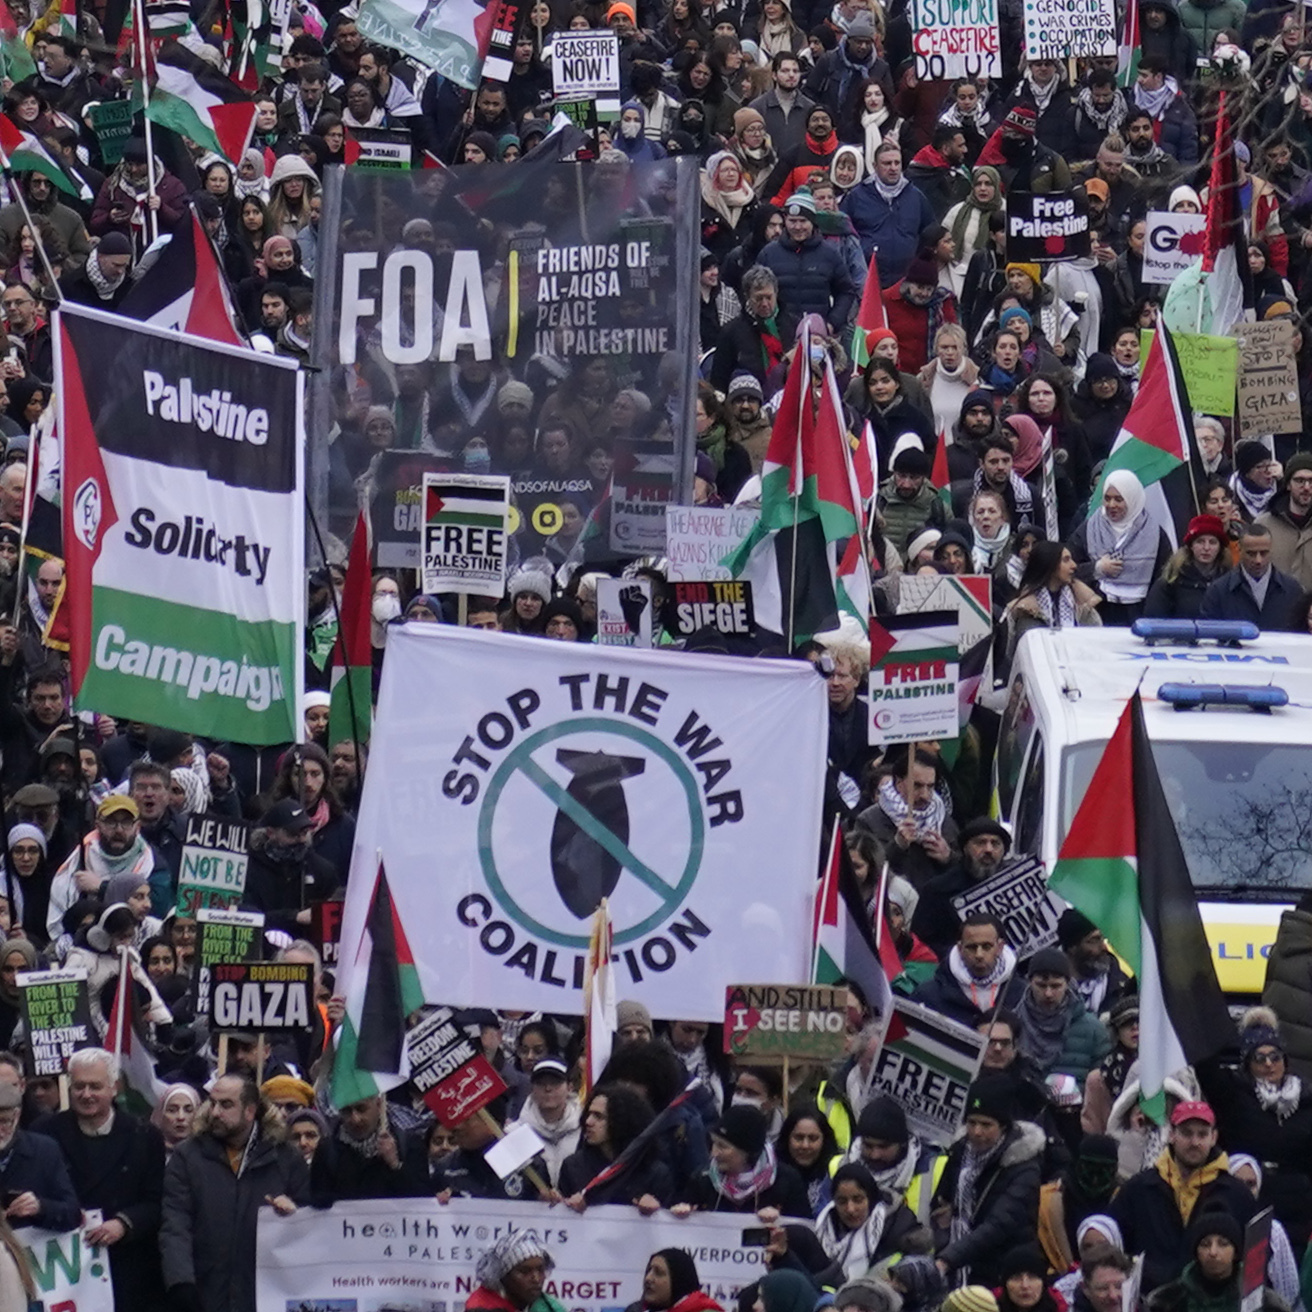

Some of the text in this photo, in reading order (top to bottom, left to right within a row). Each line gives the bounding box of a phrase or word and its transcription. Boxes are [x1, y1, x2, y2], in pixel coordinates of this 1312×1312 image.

[1038, 12, 1112, 29] WAR CRIMES
[913, 26, 999, 57] CEASEFIRE
[1039, 28, 1117, 43] OCCUPATION
[554, 39, 615, 59] CEASEFIRE
[1039, 41, 1109, 60] HYPOCRISY
[562, 58, 611, 82] NOW!
[915, 53, 946, 82] DO
[1032, 197, 1075, 217] Free
[1009, 214, 1088, 238] Palestine
[538, 242, 652, 274] FRIENDS OF
[538, 270, 621, 302] AL-AQSA
[339, 249, 493, 365] FOA
[536, 299, 598, 328] PEACE
[535, 327, 669, 355] IN PALESTINE
[1241, 349, 1286, 365] STOP
[143, 370, 269, 445] Palstine
[1244, 392, 1289, 412] GAZA
[425, 526, 504, 558] FREE
[425, 554, 503, 572] PALESTINE
[675, 582, 745, 603] END THE
[676, 602, 749, 633] SIEGE
[95, 624, 286, 712] Campaign
[883, 660, 948, 686] FREE
[872, 682, 956, 703] PALESTINE
[441, 672, 745, 829] STOP THE WAR
[187, 818, 248, 854] WE WILL
[181, 854, 245, 887] NOT BE
[203, 924, 254, 942] FROM THE
[455, 892, 713, 991] COALIION
[202, 938, 233, 954] RIVER
[216, 965, 308, 982] STOP BOMBING
[25, 982, 80, 1003] FROM THE
[213, 981, 309, 1027] GAZA
[730, 987, 836, 1009] AND STILL
[27, 997, 76, 1017] RIVER TO
[29, 1012, 75, 1031] THE SEA
[732, 1008, 845, 1034] I SEE NO
[30, 1025, 89, 1047] PALESTINE
[32, 1044, 60, 1061] WILL
[34, 1059, 62, 1077] FREE
[412, 1040, 477, 1093] PALESTINE
[881, 1044, 970, 1111] FREE
[869, 1073, 961, 1127] PALESTINE
[332, 1274, 450, 1290] Health workers are
